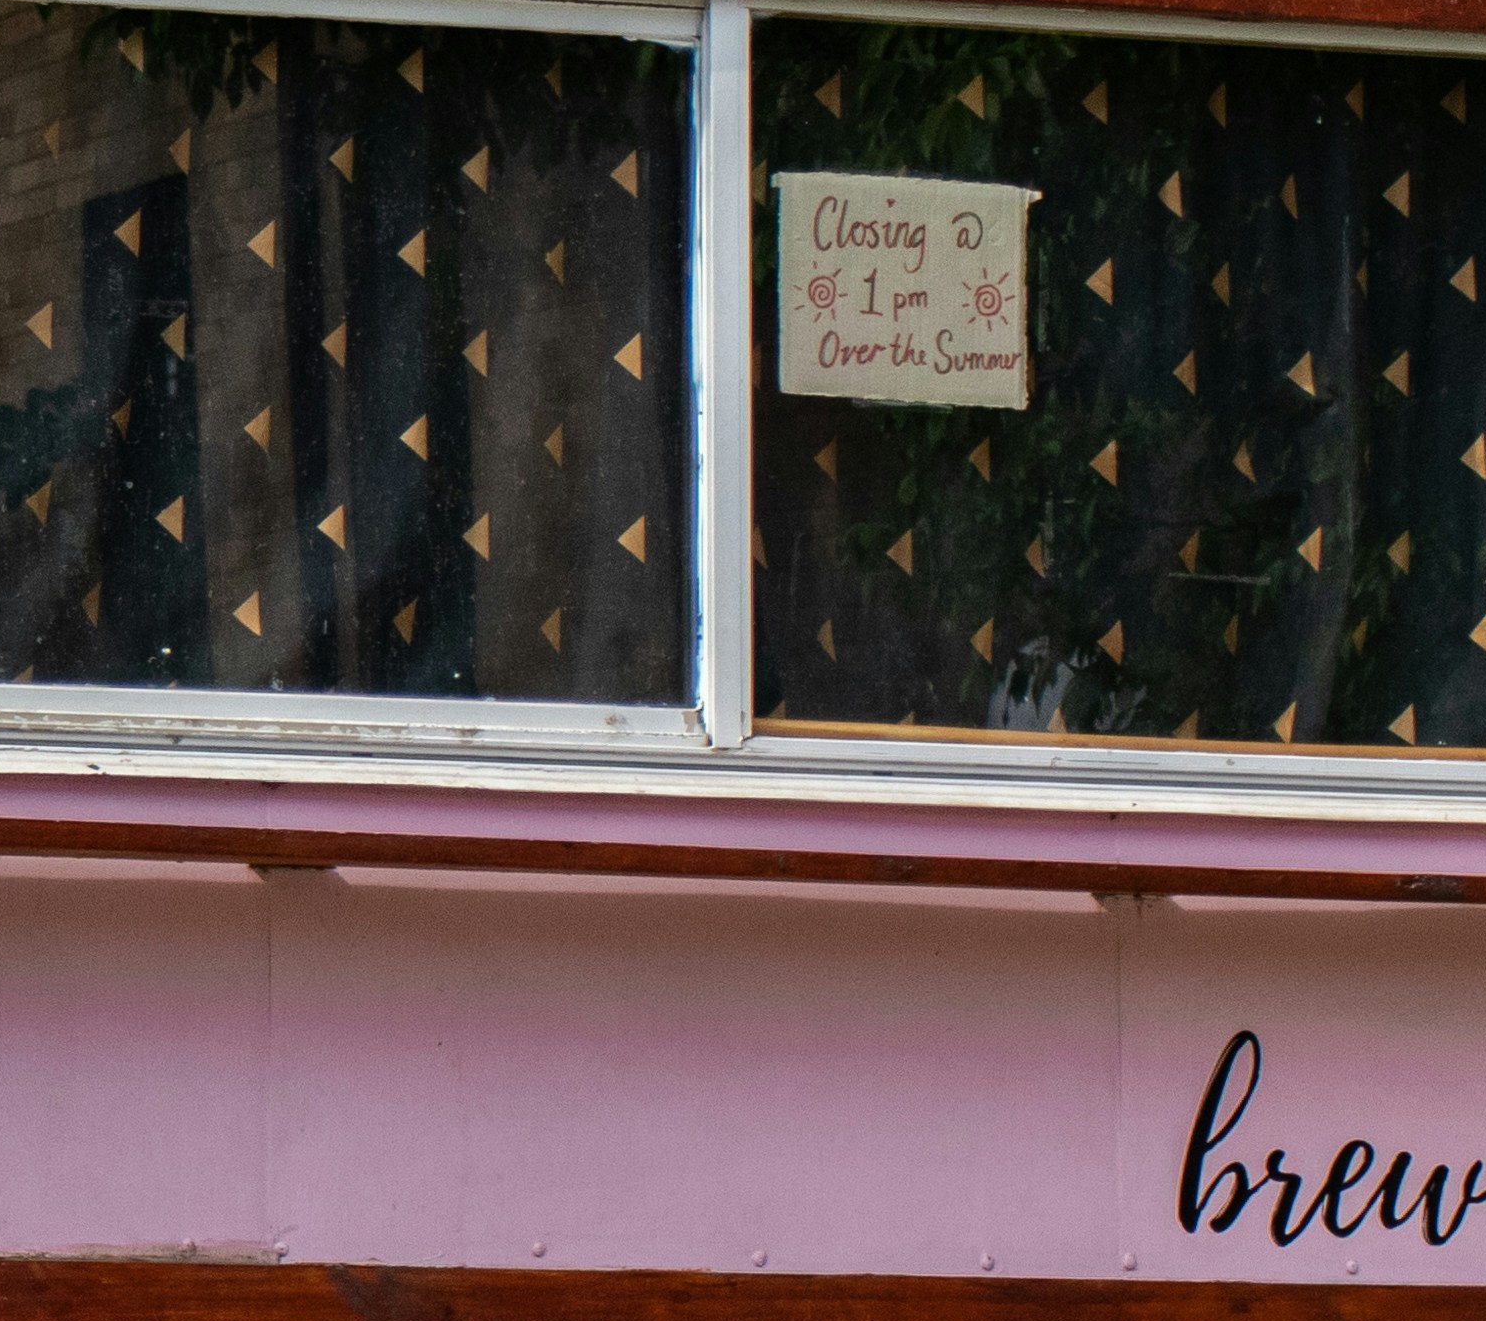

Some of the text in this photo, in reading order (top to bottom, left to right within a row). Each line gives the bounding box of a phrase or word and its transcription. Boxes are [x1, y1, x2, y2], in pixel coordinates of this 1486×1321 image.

[813, 196, 983, 273] Closing @
[860, 268, 927, 322] 1 pm
[818, 329, 1022, 374] Over the Summer
